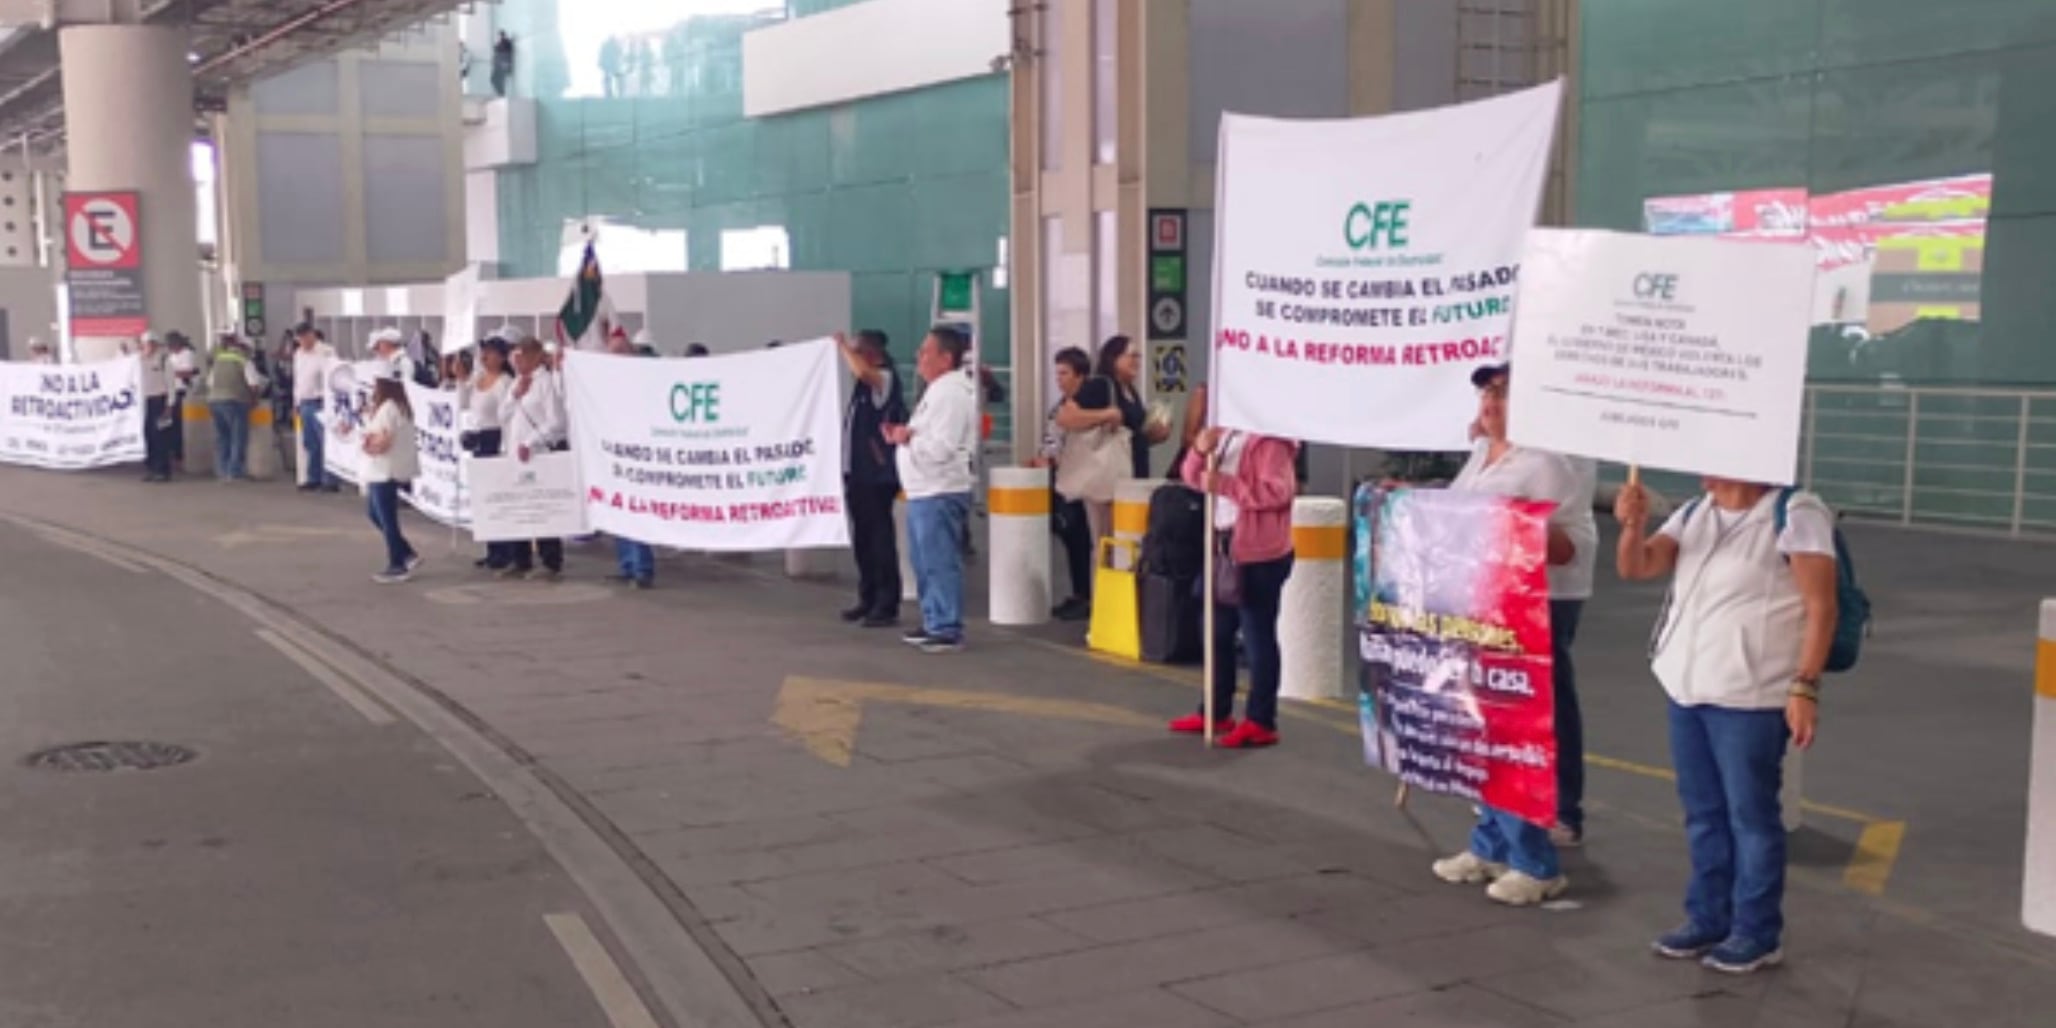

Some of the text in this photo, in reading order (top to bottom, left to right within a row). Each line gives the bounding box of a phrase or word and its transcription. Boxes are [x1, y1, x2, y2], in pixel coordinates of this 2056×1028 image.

[1344, 201, 1410, 249] CFE
[1246, 270, 1315, 297] CUANDO
[1321, 281, 1342, 299] SE
[1347, 279, 1416, 299] CAMBIA
[1421, 278, 1444, 297] EL
[1634, 272, 1680, 300] CFE
[1256, 300, 1275, 319] SE
[1281, 304, 1403, 327] COMPROMETE
[1408, 307, 1427, 327] EL
[1256, 334, 1269, 353] A
[1274, 337, 1299, 358] LA
[1304, 341, 1396, 366] REFORMA
[1402, 335, 1503, 366] RETROAC
[670, 382, 719, 422] CFE
[677, 448, 731, 466] CAMBIA
[734, 447, 751, 465] EL
[626, 465, 723, 489] COMPROMETE
[726, 473, 745, 489] EL
[611, 491, 624, 510] A
